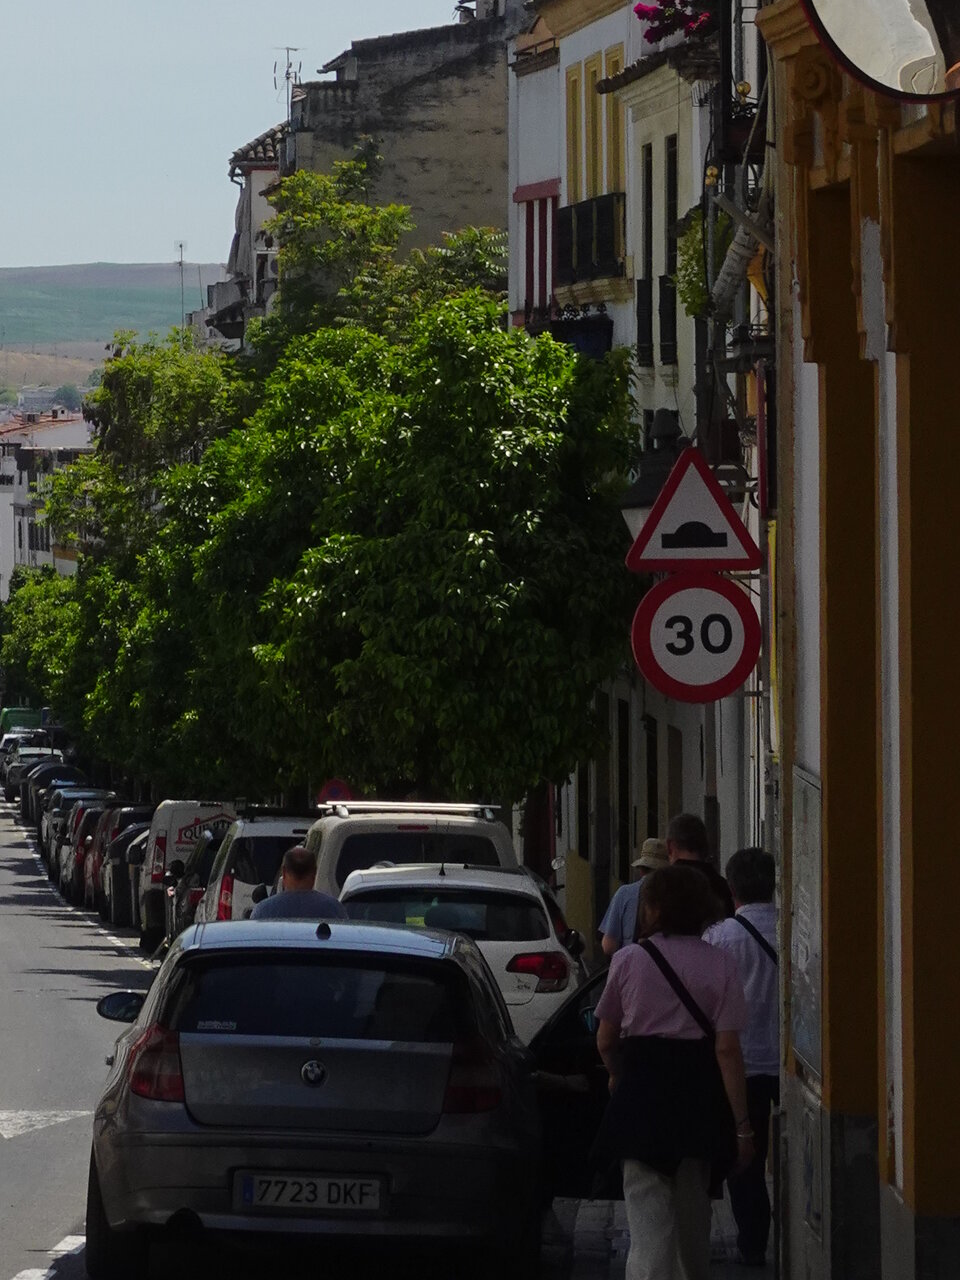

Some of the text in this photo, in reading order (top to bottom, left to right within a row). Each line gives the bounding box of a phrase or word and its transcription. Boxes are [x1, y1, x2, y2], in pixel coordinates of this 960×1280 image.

[665, 613, 732, 655] 30
[258, 1180, 372, 1205] 7723 DKF
